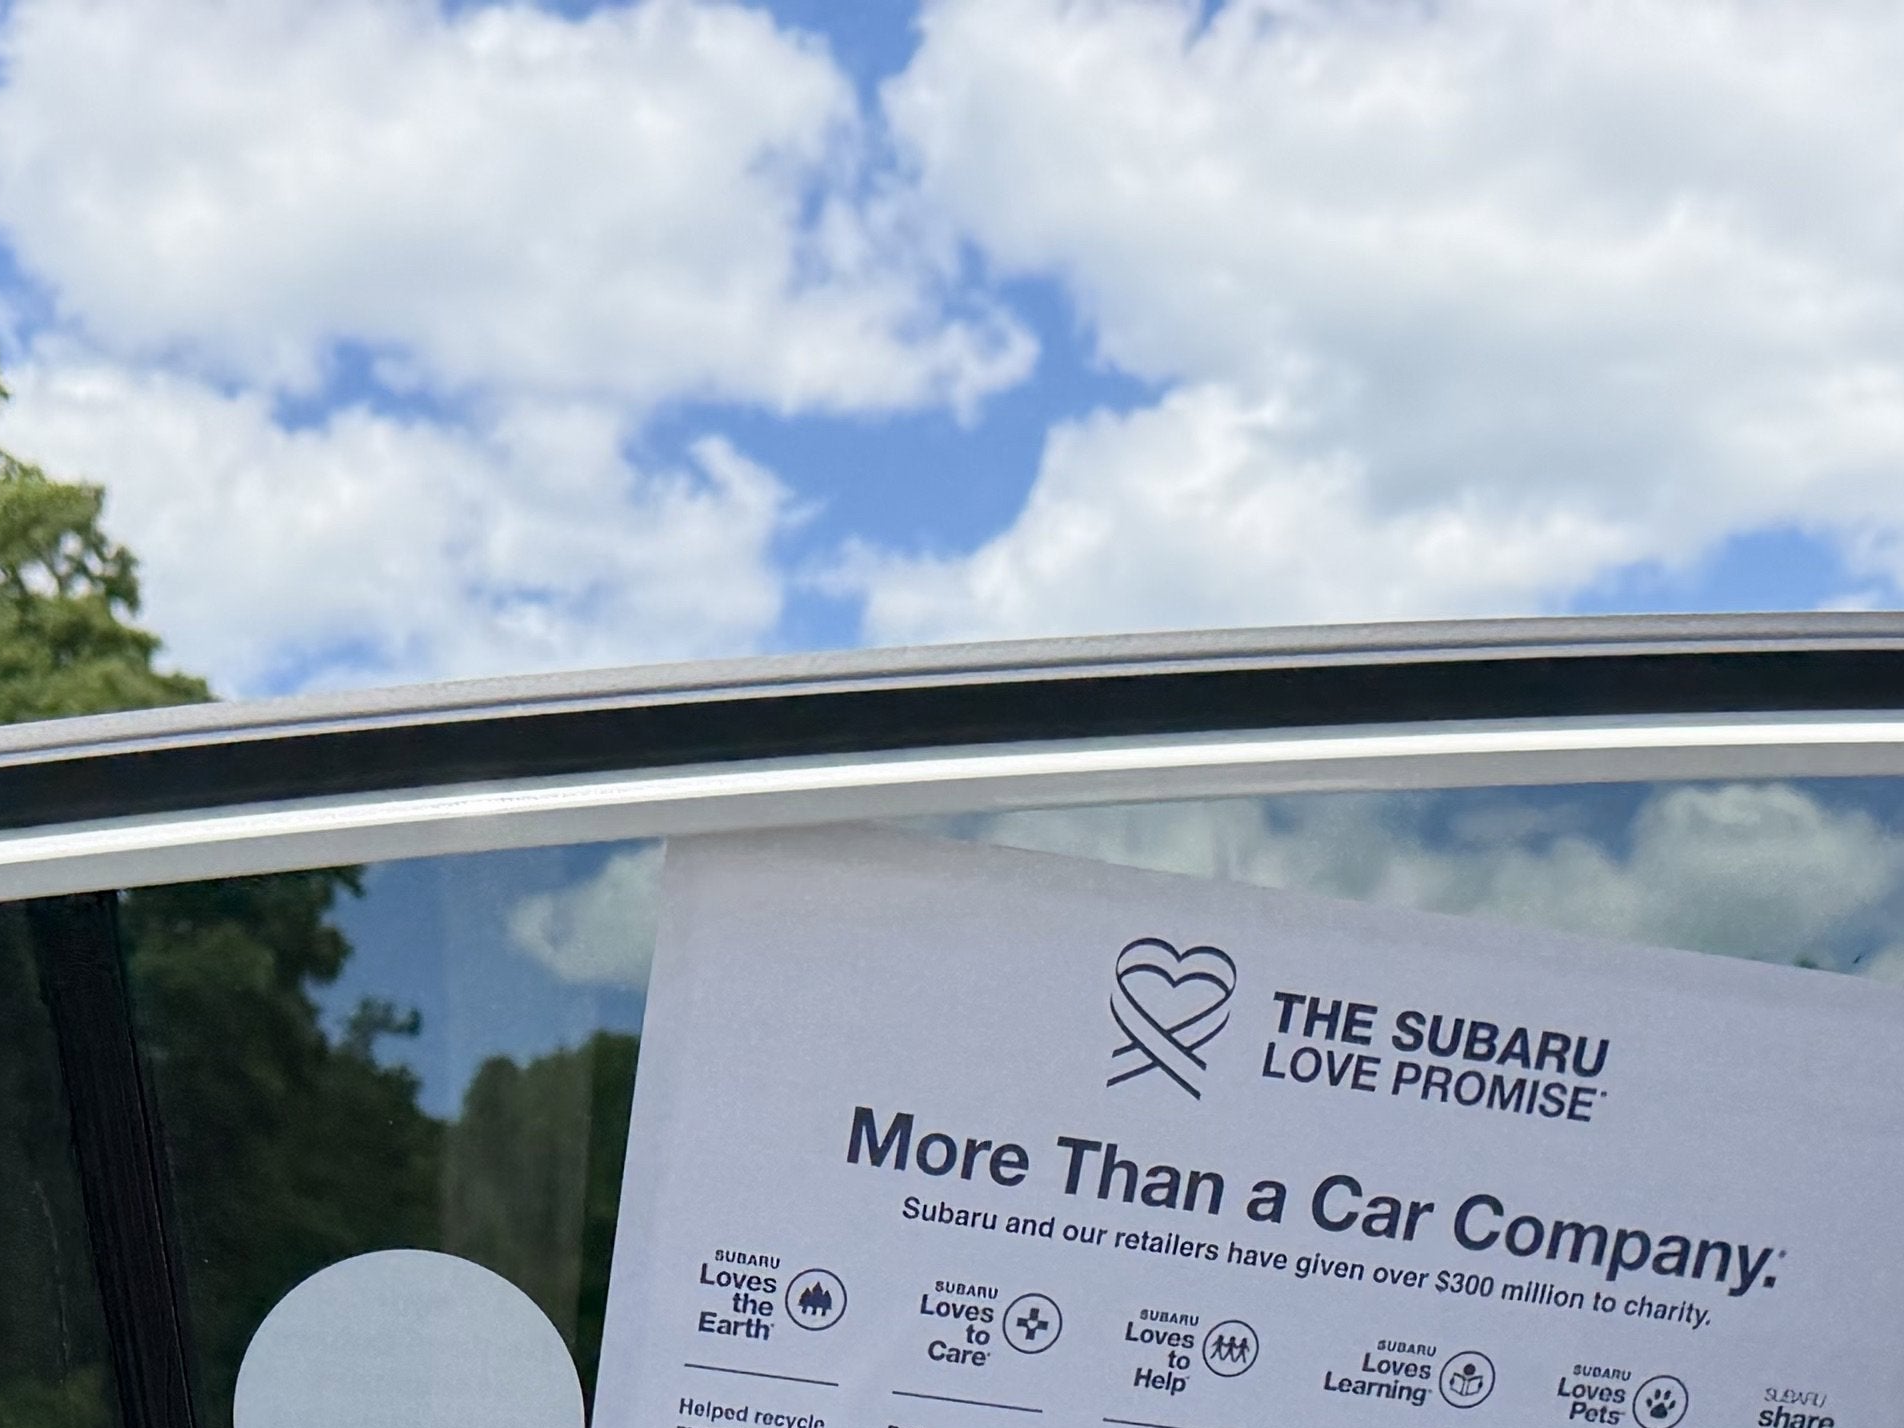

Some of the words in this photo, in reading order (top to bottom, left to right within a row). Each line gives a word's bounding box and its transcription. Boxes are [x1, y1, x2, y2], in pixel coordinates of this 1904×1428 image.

[1273, 991, 1379, 1047] THE
[1391, 1010, 1610, 1078] SUBARU
[1262, 1041, 1382, 1093] LOVE
[1391, 1060, 1608, 1123] PROMISE
[846, 1106, 1030, 1187] More
[1056, 1135, 1225, 1216] Than
[1246, 1179, 1287, 1224] a
[1311, 1174, 1435, 1242] Car
[714, 1249, 781, 1270] SUBARU
[902, 1195, 998, 1231] Subaru
[1005, 1216, 1056, 1239] and
[1062, 1224, 1109, 1246] our
[1114, 1230, 1219, 1261] retailers
[1227, 1240, 1288, 1270] have
[1294, 1252, 1365, 1281] given
[1372, 1266, 1430, 1289] over
[1434, 1269, 1495, 1298] $300
[1500, 1280, 1585, 1310] million
[1592, 1291, 1617, 1313] to
[1623, 1294, 1711, 1330] charity.
[699, 1262, 777, 1294] Loves
[934, 1280, 999, 1300] SUBARU
[732, 1292, 774, 1317] the
[919, 1293, 994, 1324] Loves
[1139, 1308, 1200, 1327] SUBARU
[965, 1323, 991, 1346] to
[1124, 1320, 1195, 1349] Loves
[1167, 1349, 1191, 1371] to
[1376, 1339, 1437, 1358] SUBARU
[1361, 1352, 1432, 1380] Loves
[1572, 1363, 1632, 1382] SUBARU
[1556, 1376, 1627, 1404] Loves
[678, 1397, 749, 1423] Helped
